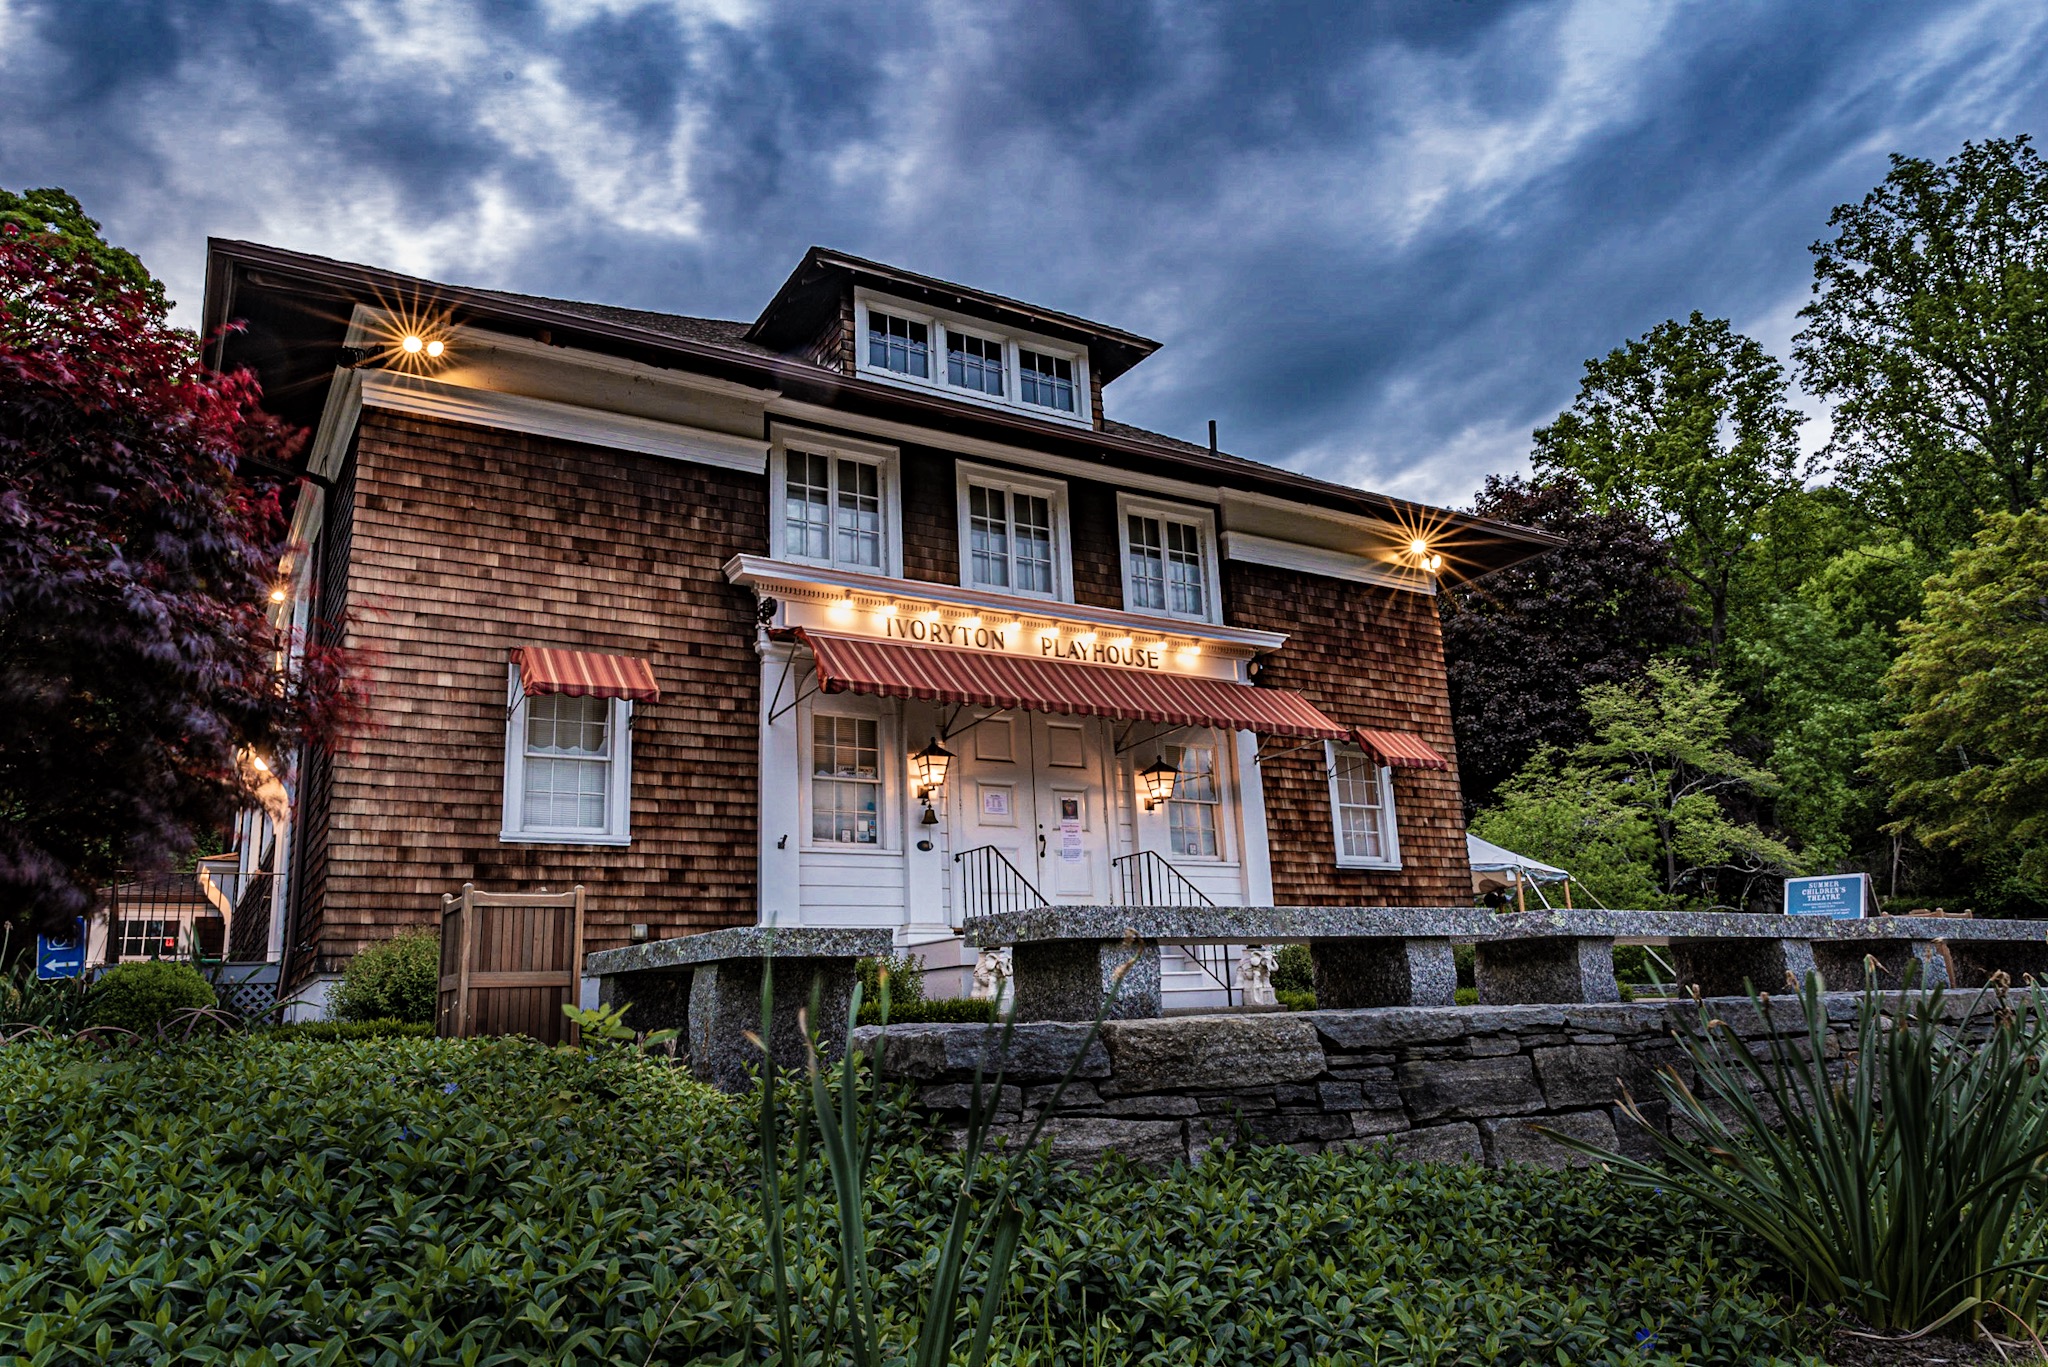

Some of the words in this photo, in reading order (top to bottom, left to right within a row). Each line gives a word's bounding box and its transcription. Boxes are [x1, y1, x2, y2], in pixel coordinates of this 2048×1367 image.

[886, 617, 1005, 650] IVORYTON
[1041, 636, 1159, 669] PLAYHOUSE
[1808, 881, 1839, 889] SUMMER
[1802, 887, 1846, 896] CHILDREN'S
[1807, 893, 1841, 901] THEATRE
